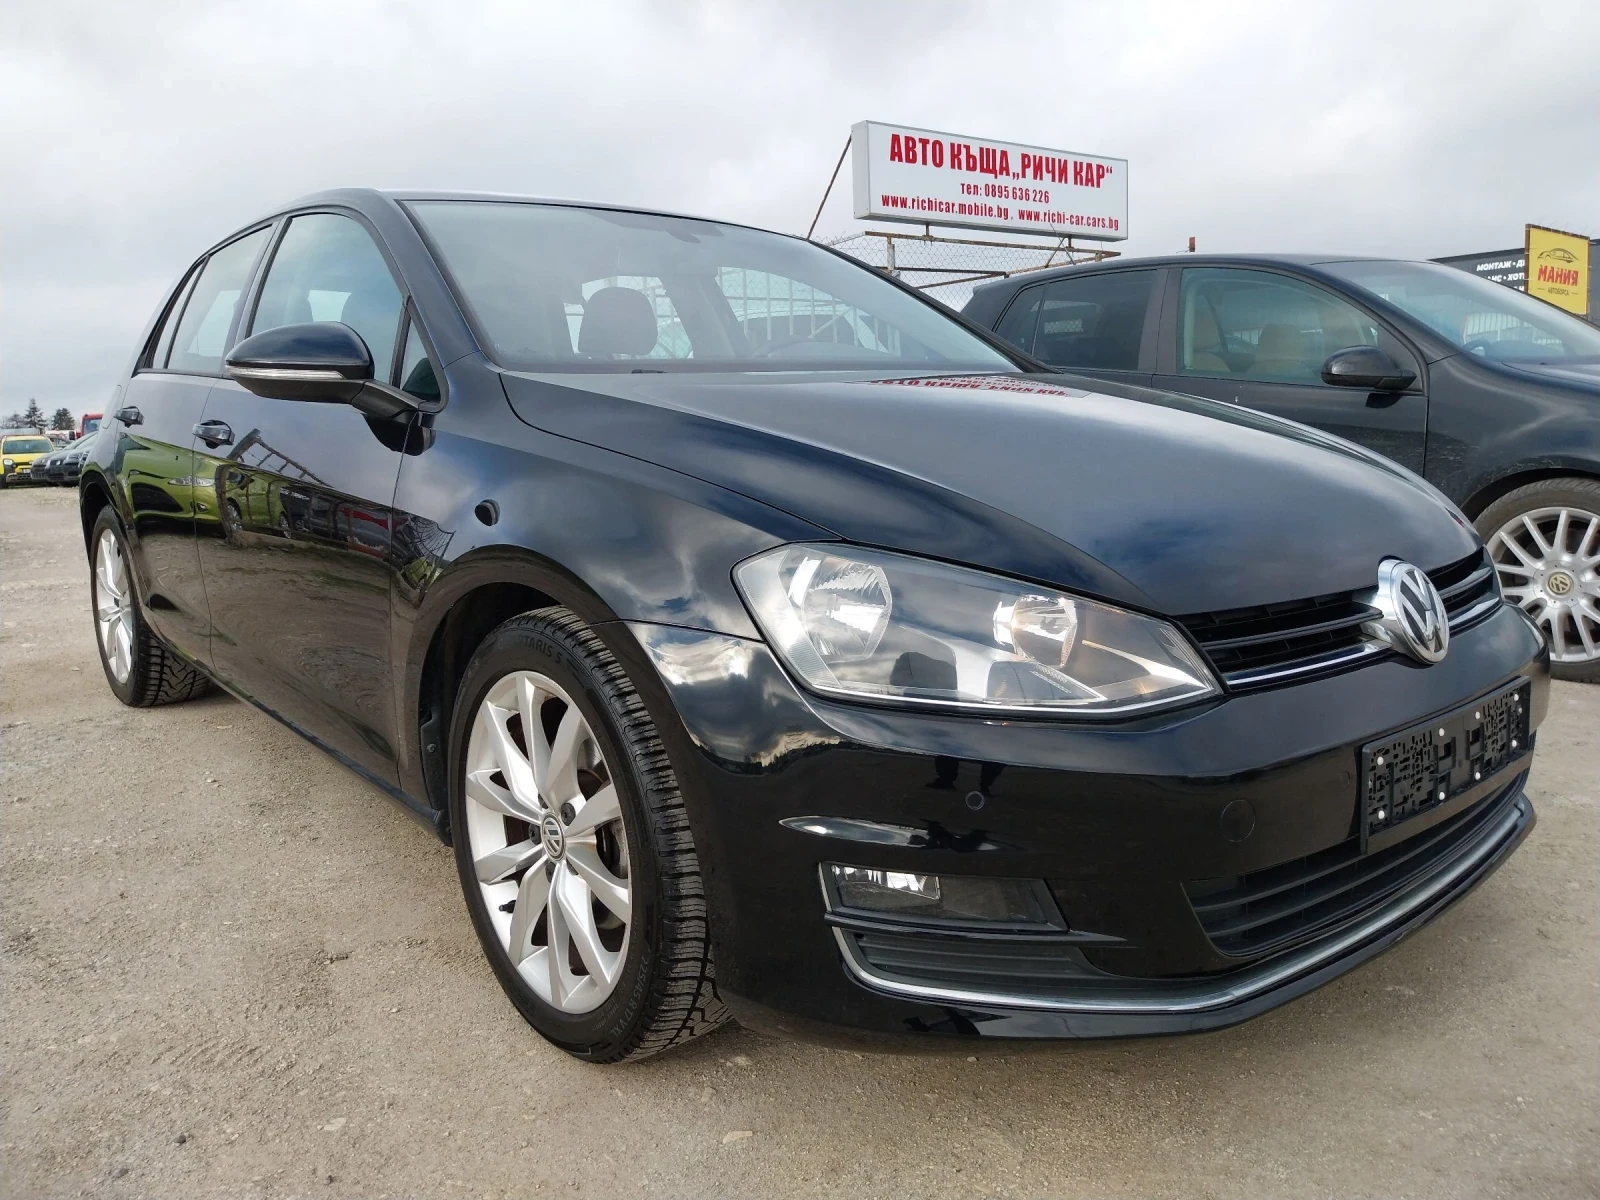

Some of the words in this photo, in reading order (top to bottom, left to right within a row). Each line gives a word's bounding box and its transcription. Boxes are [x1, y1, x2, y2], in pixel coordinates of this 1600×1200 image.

[889, 132, 944, 169] АВТО
[949, 142, 1010, 179] КЪЩА
[984, 183, 1010, 200] 0895
[1012, 186, 1031, 202] 636
[1032, 189, 1050, 204] 226
[1018, 209, 1119, 231] www.richi-car.cars.bg
[1476, 260, 1512, 272] МОНТАЖ
[1537, 264, 1579, 287] МАНИЯ
